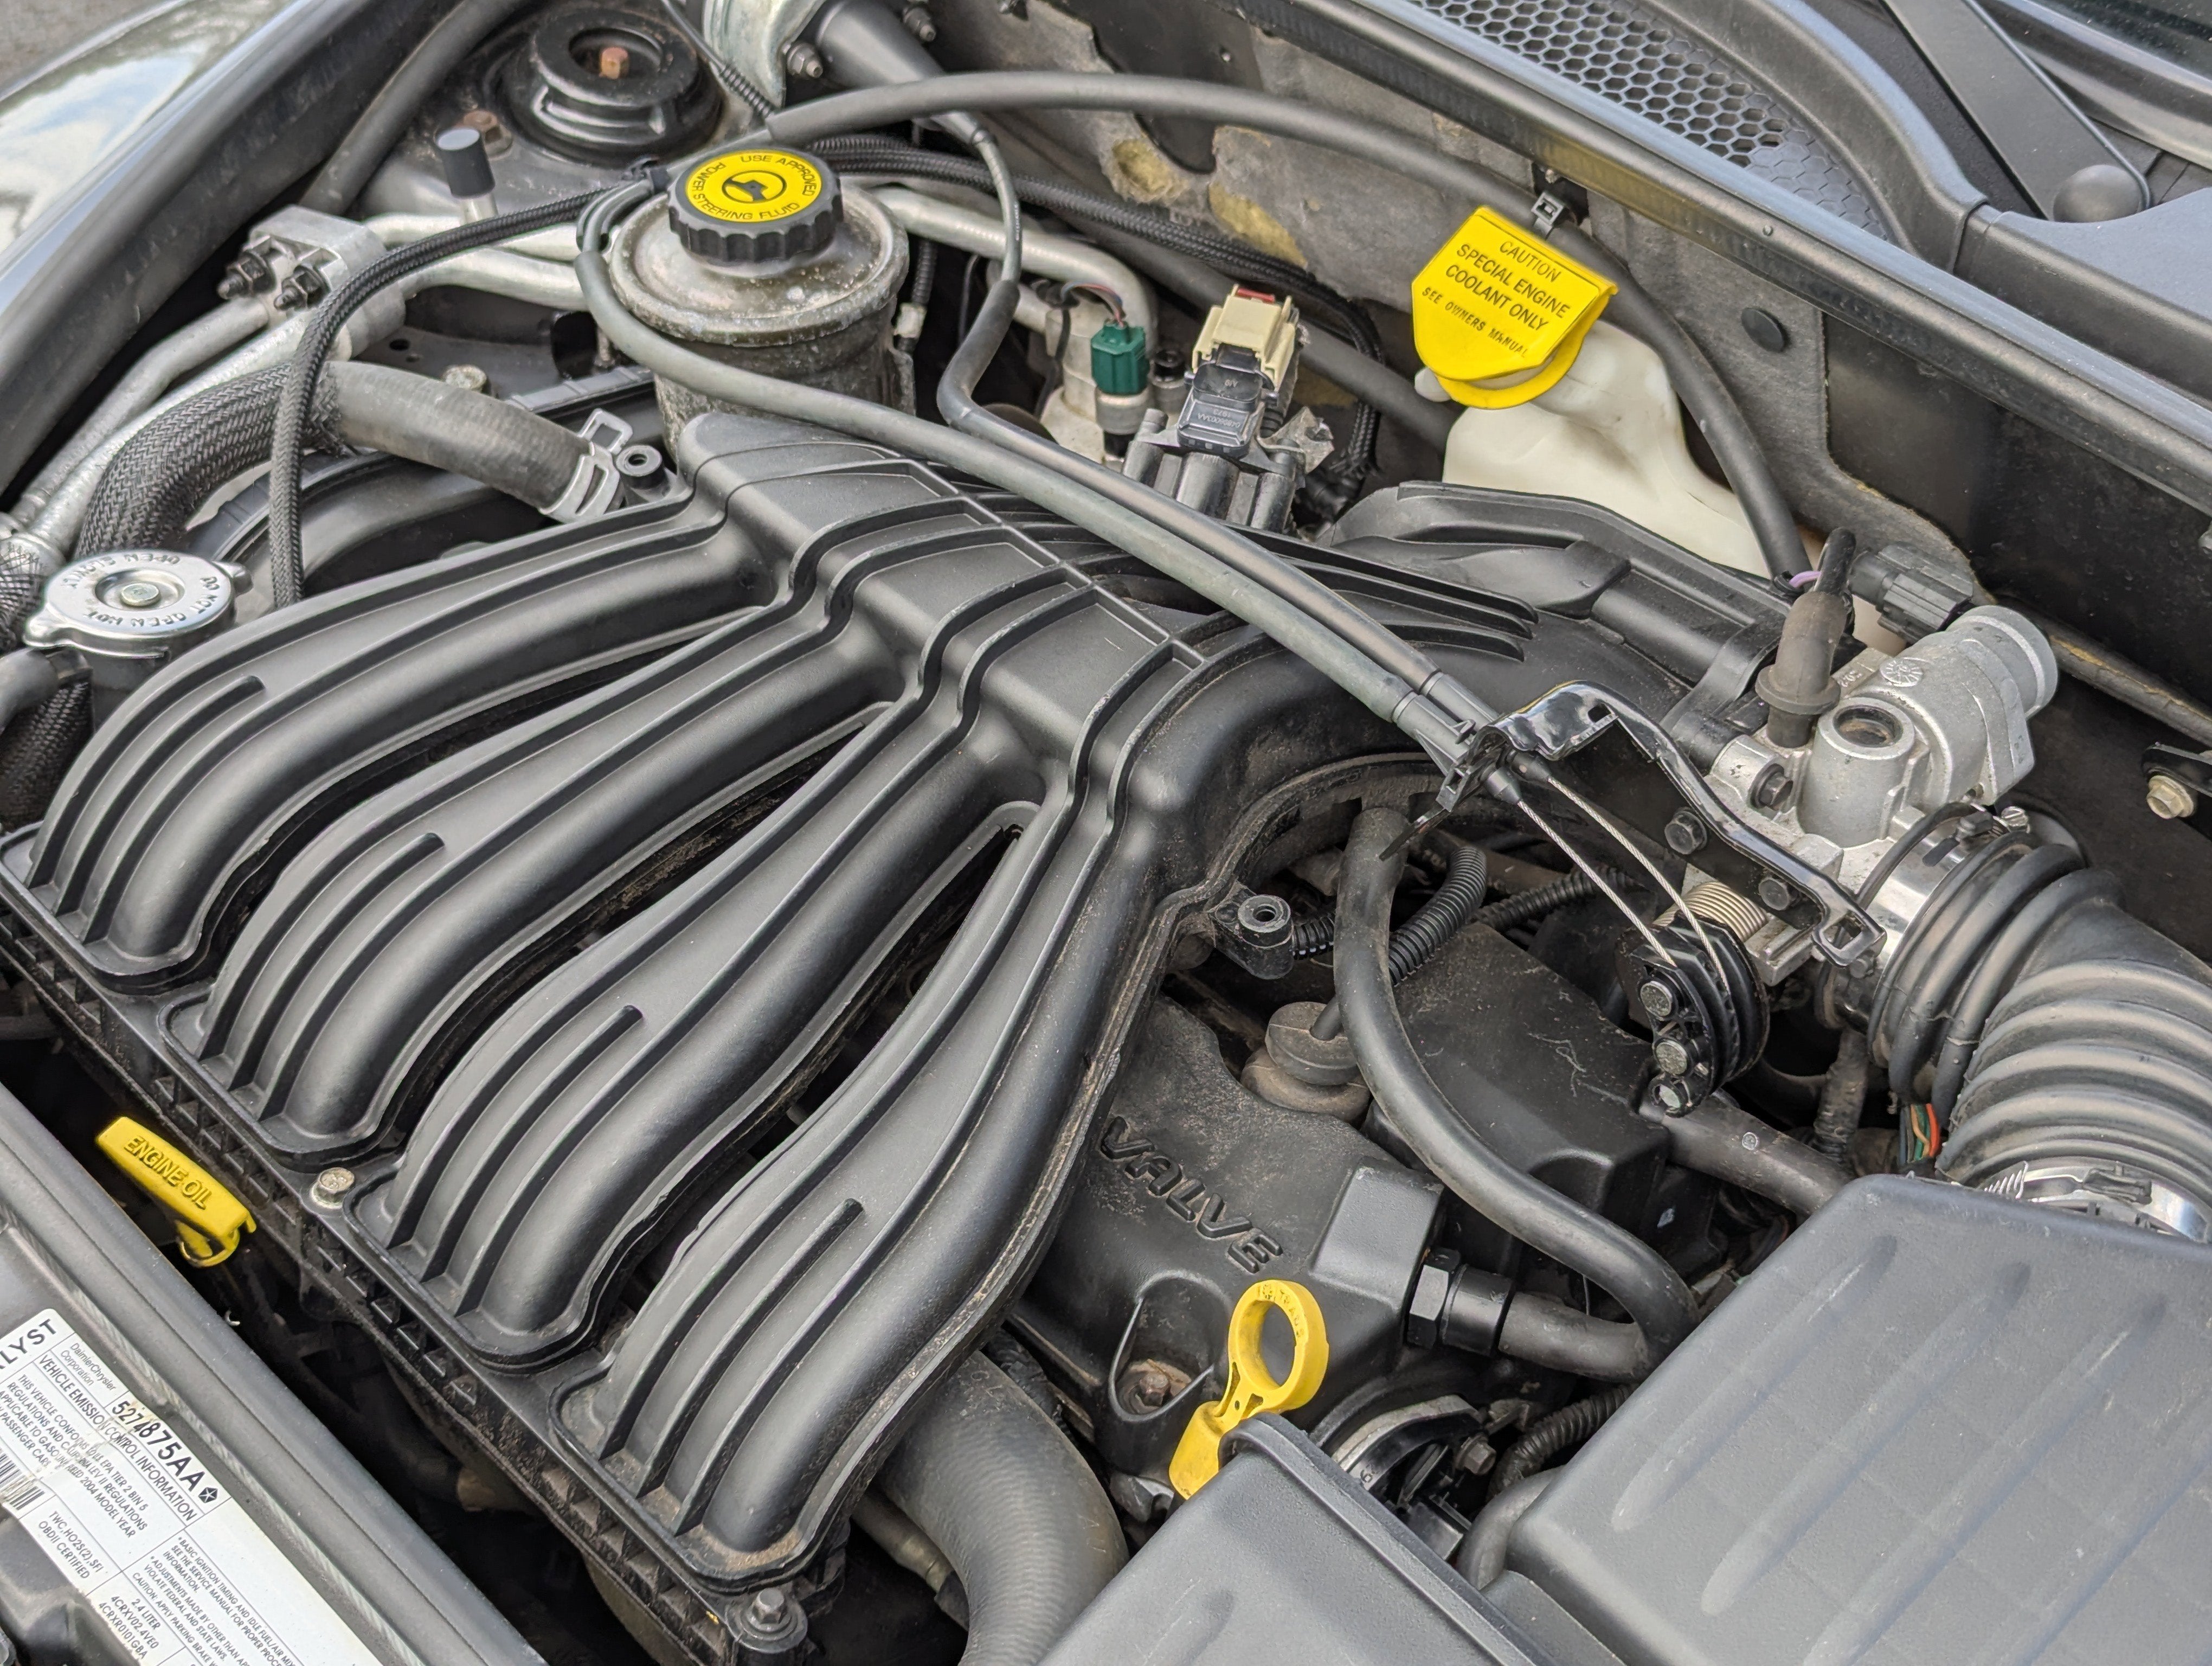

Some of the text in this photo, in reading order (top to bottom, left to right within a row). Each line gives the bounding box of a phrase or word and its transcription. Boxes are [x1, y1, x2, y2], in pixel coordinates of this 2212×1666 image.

[692, 162, 800, 220] POWER STEERING FLUID
[741, 155, 817, 197] USE APPROVED
[1445, 264, 1549, 331] COOLANT ONLY
[1456, 244, 1571, 319] SPECIAL ENGINE
[1500, 240, 1561, 283] CAUTION
[1422, 286, 1528, 358] SEE OWNERS MANUAL
[124, 553, 180, 565] OPEN
[83, 576, 220, 627] DO NOT OPEN HOT
[124, 1136, 212, 1210] ENGINE OIL
[1101, 1116, 1283, 1274] VALVE
[61, 1350, 94, 1386] Corporation
[70, 1343, 116, 1391] DaimlerChrysler
[0, 1412, 35, 1450] PASSENGER
[0, 1391, 34, 1428] APPLICABLE
[30, 1426, 41, 1437] TO
[80, 1477, 99, 1494] 2004
[94, 1492, 119, 1519] MODEL
[117, 1517, 136, 1537] YEAR
[7, 1382, 50, 1427] REGULATIONS
[46, 1427, 63, 1442] AND
[88, 1466, 104, 1478] LEV
[104, 1483, 147, 1530] REGULATIONS
[18, 1374, 34, 1389] THIS
[30, 1388, 57, 1415] VEHICLE
[100, 1460, 114, 1473] EPA
[111, 1471, 127, 1487] TIER
[128, 1491, 144, 1505] BIN
[40, 1355, 197, 1521] VEHICLE EMISSION CONTROL INFORMATION
[112, 1400, 205, 1492] 5274875AA
[39, 1521, 89, 1578] OBDII CERTIFIED
[163, 1551, 200, 1593] INFORMATION.
[131, 1599, 160, 1630] 2.4 LITER
[133, 1573, 211, 1663] CAUTION: APPLY PARKING BRAKE
[144, 1564, 167, 1589] VIOLATE
[164, 1588, 187, 1613] FEDERAL
[184, 1613, 198, 1626] AND
[196, 1626, 213, 1643] STATE
[210, 1642, 227, 1661] LAWS.
[152, 1560, 188, 1598] ADJUSTMENTS
[184, 1597, 203, 1616] MADE
[200, 1613, 210, 1624] BY
[208, 1623, 226, 1642] OTHER
[223, 1641, 240, 1658] THAN
[171, 1546, 183, 1556] SEE
[180, 1555, 192, 1567] THE
[189, 1566, 212, 1590] SERVICE
[209, 1589, 233, 1614] MANUAL
[231, 1613, 244, 1626] FOR
[241, 1626, 263, 1649] PROPER
[179, 1540, 197, 1558] BASIC
[195, 1557, 220, 1584] IGNITION
[218, 1582, 238, 1604] TIMING
[236, 1605, 249, 1618] AND
[248, 1617, 261, 1631] IDLE
[259, 1630, 284, 1657] FUEL/AIR
